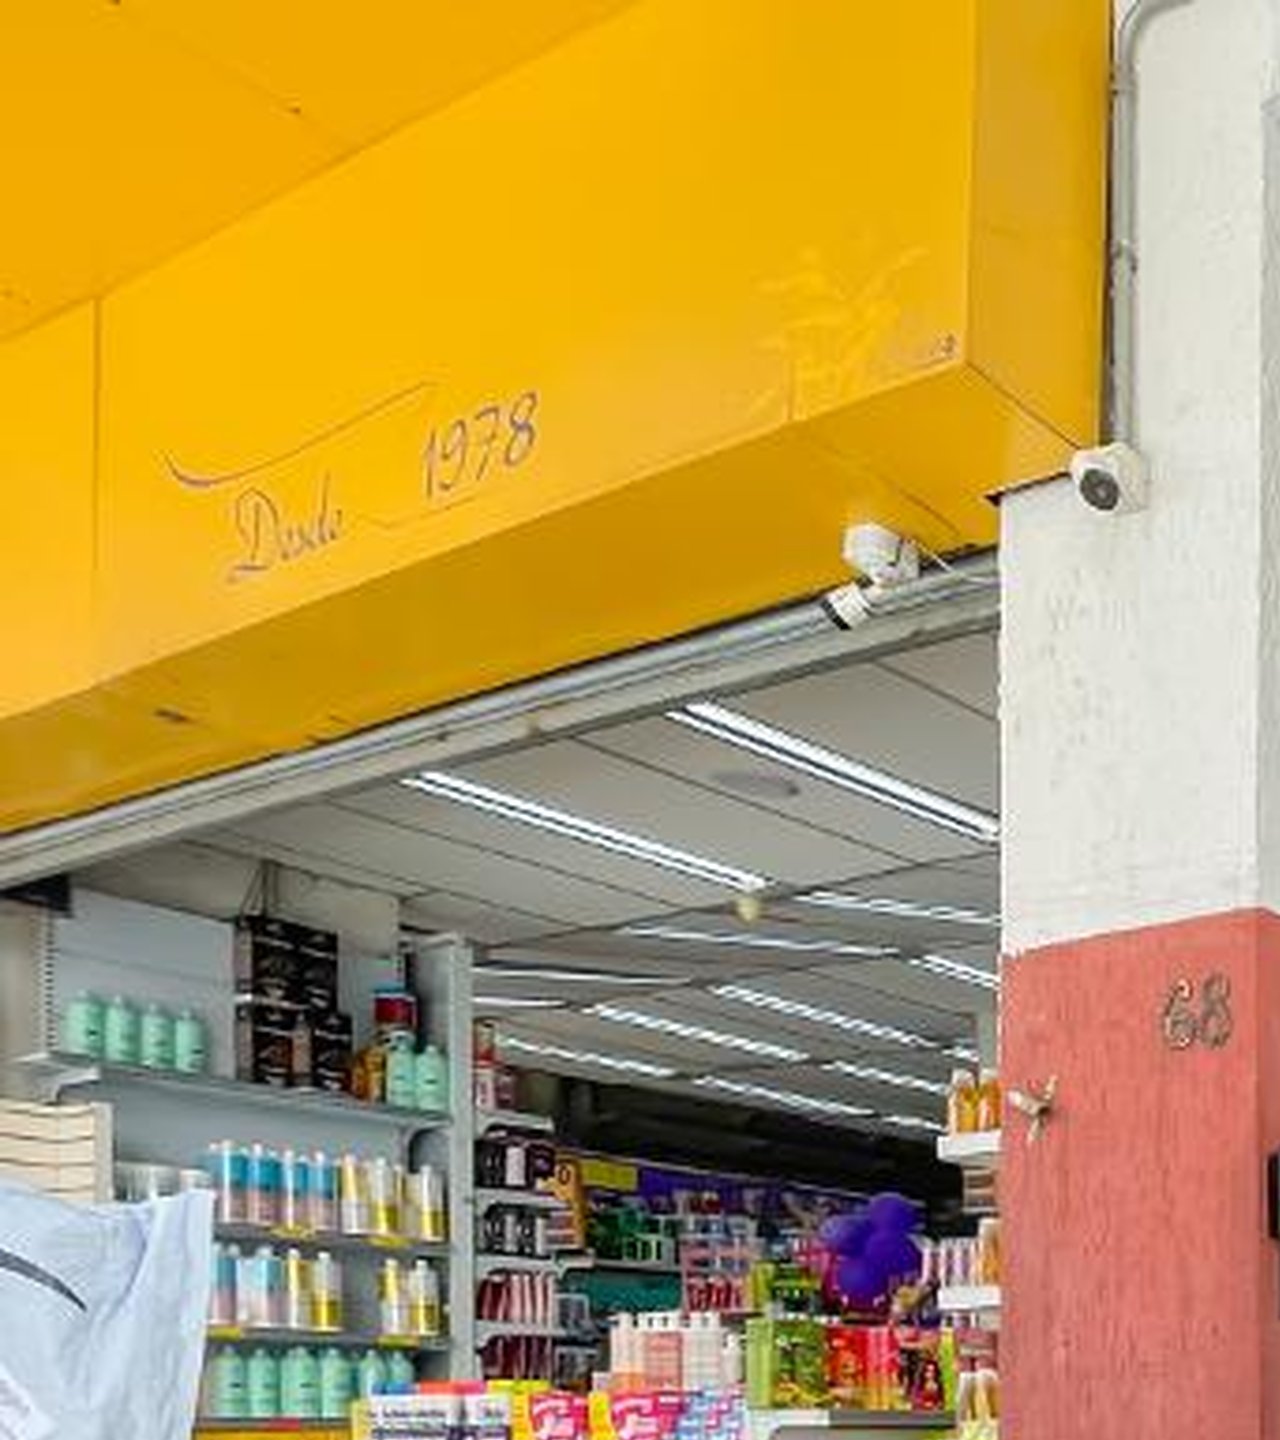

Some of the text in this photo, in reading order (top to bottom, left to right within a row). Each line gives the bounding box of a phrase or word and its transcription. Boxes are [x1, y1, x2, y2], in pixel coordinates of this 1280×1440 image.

[228, 391, 539, 580] Desde 1978
[1162, 973, 1233, 1050] 68
